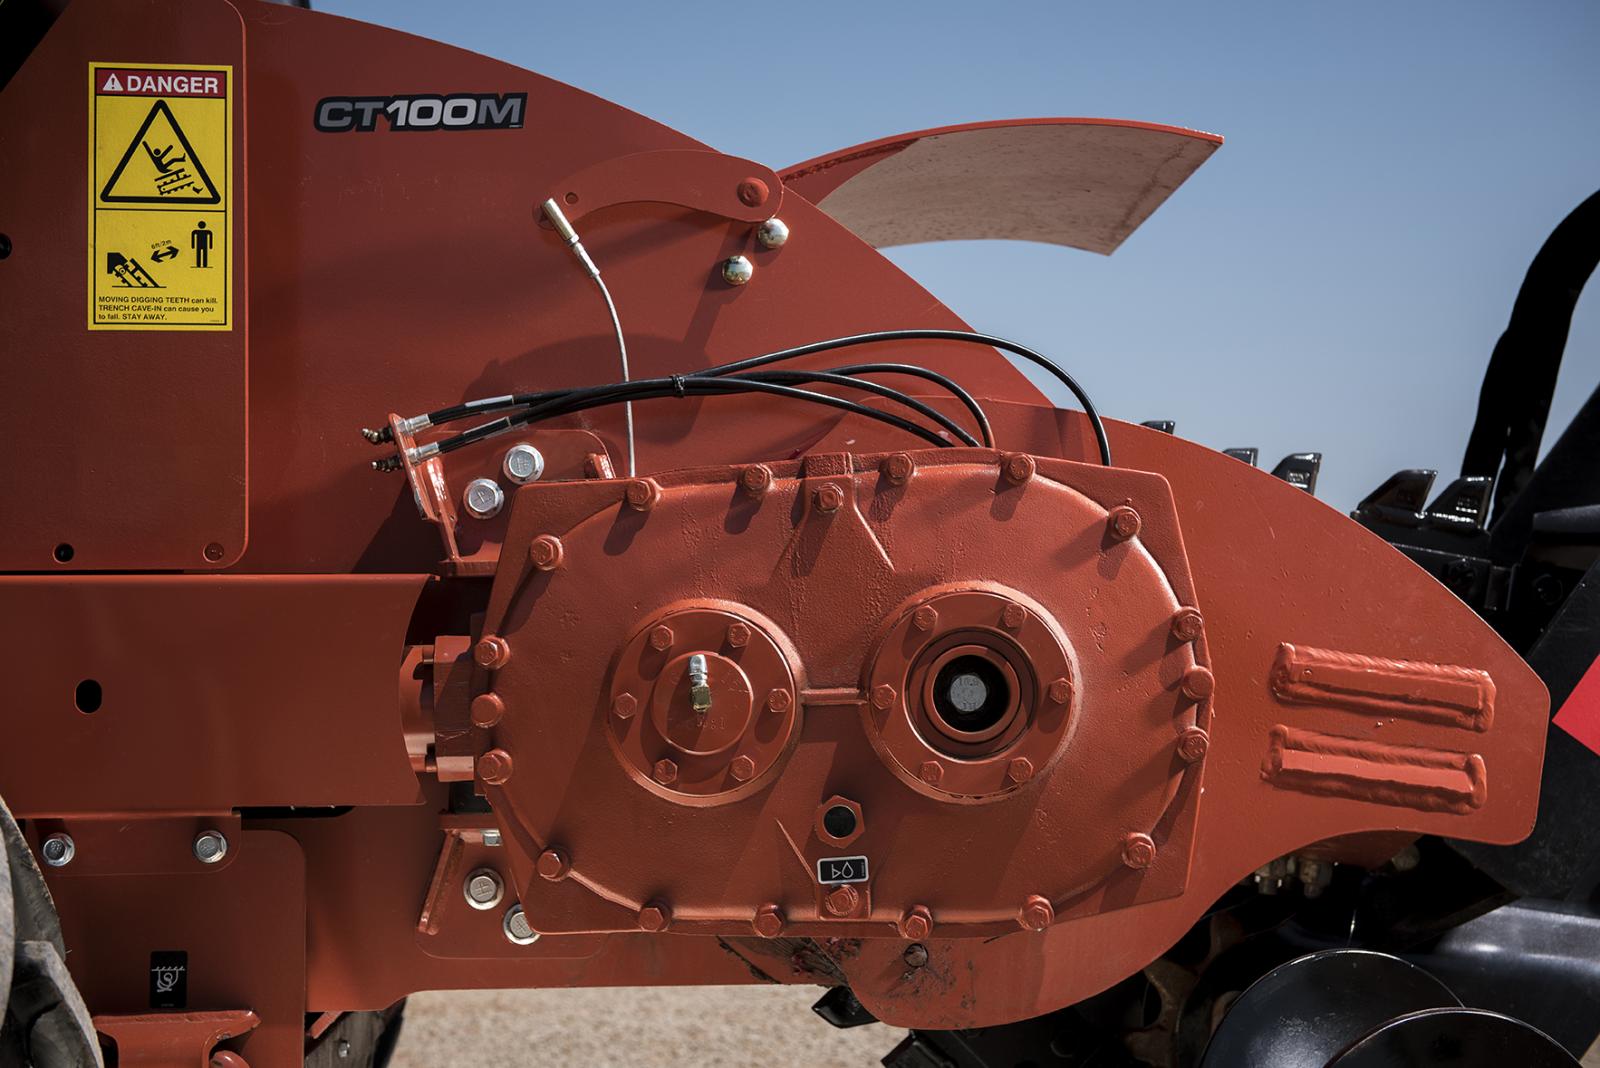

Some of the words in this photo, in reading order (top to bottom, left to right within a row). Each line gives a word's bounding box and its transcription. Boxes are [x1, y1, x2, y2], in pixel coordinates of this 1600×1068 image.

[127, 75, 219, 94] DANGER
[318, 98, 523, 128] CT100M
[131, 296, 164, 304] DIGGING
[99, 304, 130, 312] TRENCH
[131, 304, 162, 312] CAVE-IN
[200, 306, 214, 314] you
[143, 313, 167, 321] AWAY.
